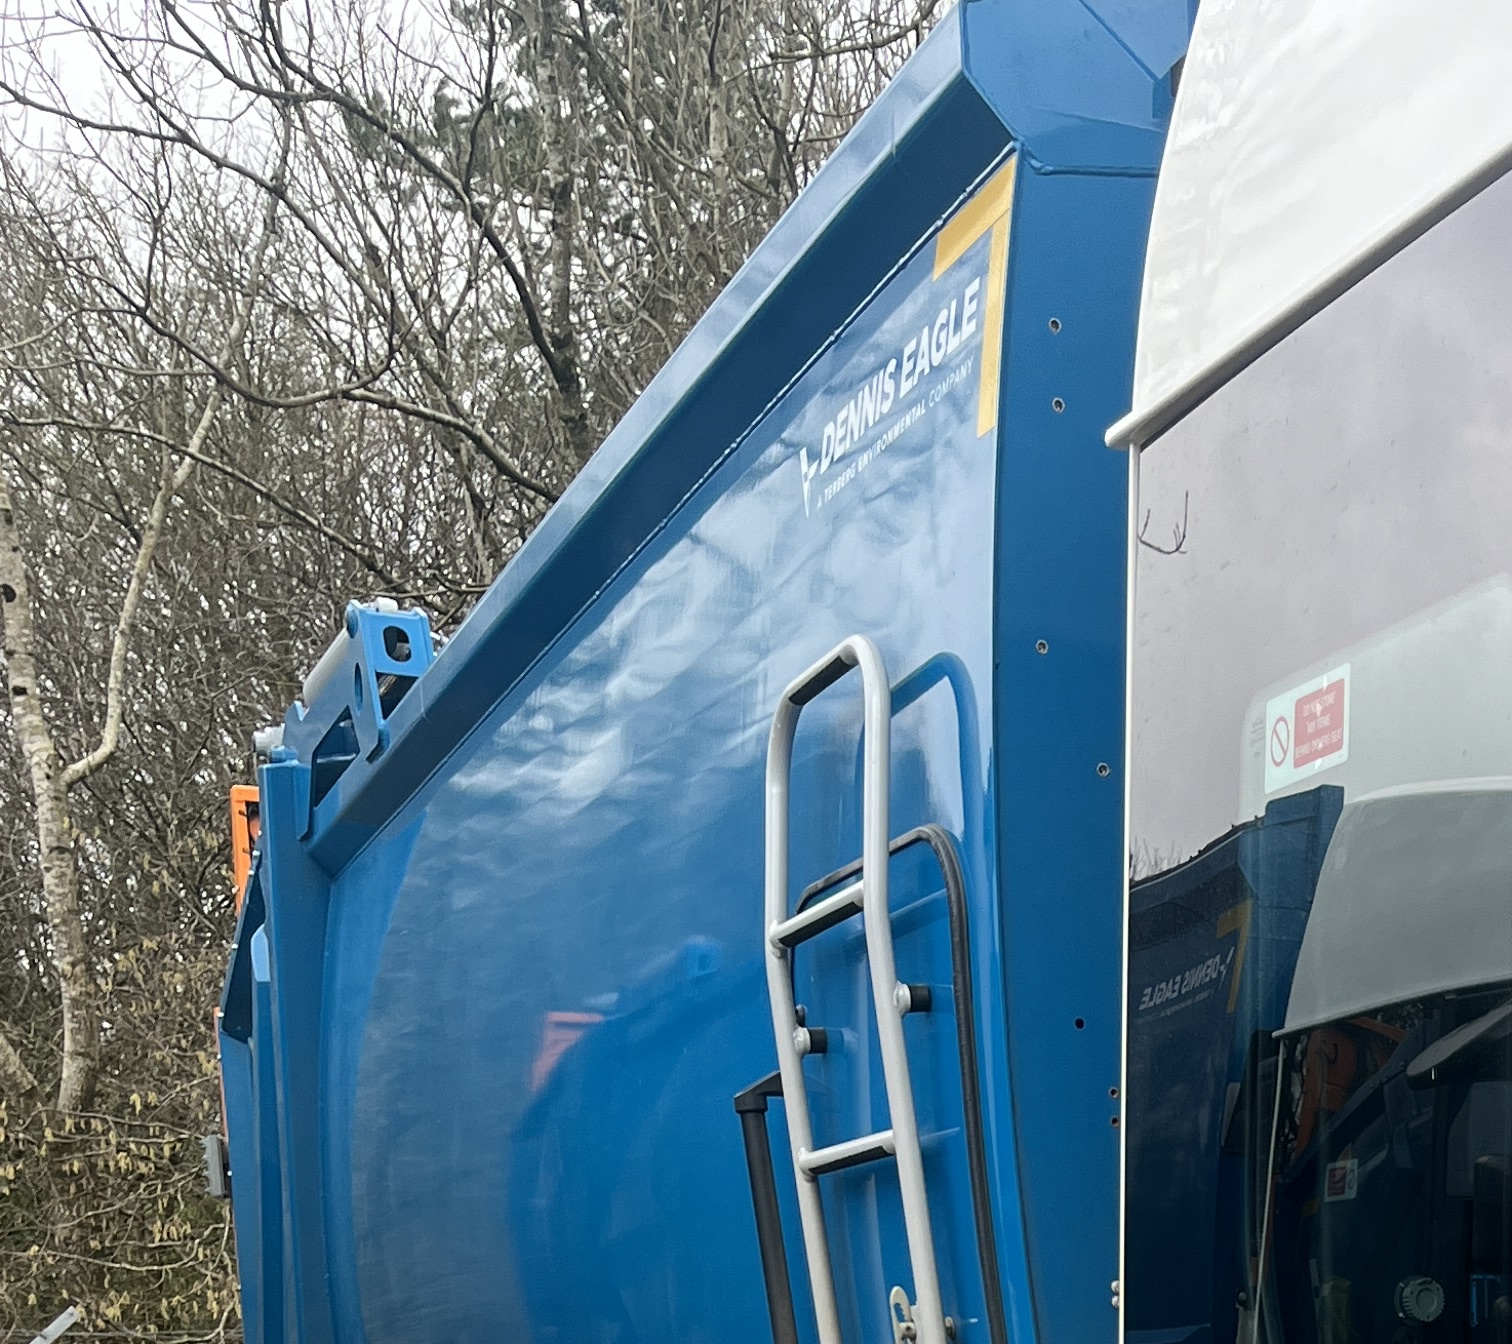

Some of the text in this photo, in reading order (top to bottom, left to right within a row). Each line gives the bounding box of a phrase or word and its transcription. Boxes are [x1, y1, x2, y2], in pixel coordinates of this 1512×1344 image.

[819, 276, 981, 475] DENNIS EAGLE
[857, 399, 926, 473] ENVIRONMENTAL
[928, 355, 975, 408] COMPANY
